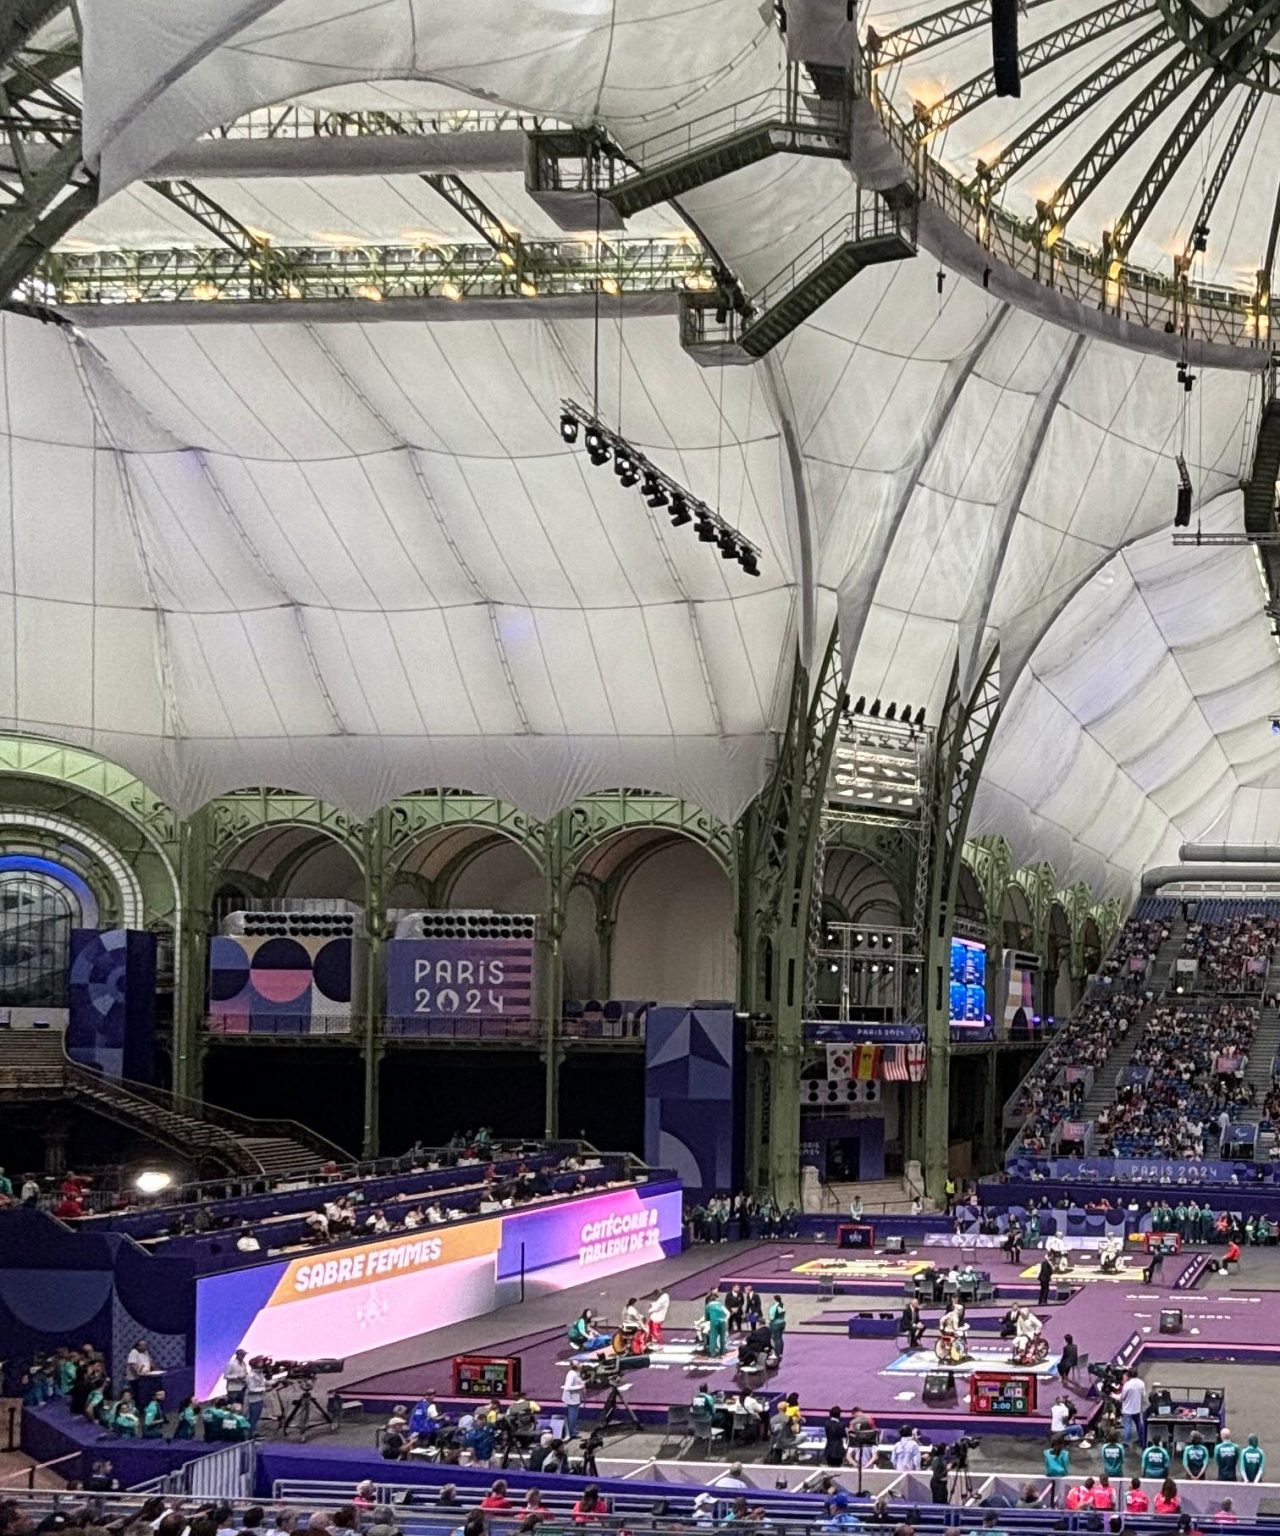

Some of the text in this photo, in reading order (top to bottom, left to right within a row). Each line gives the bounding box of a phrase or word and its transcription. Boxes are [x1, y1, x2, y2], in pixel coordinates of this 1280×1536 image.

[414, 959, 504, 985] PARIS
[414, 988, 504, 1014] 2024
[1131, 1165, 1217, 1177] PARIS 2024
[578, 1235, 629, 1266] TABLEAU
[629, 1231, 645, 1252] DE
[295, 1238, 442, 1292] SABRE FEMMES
